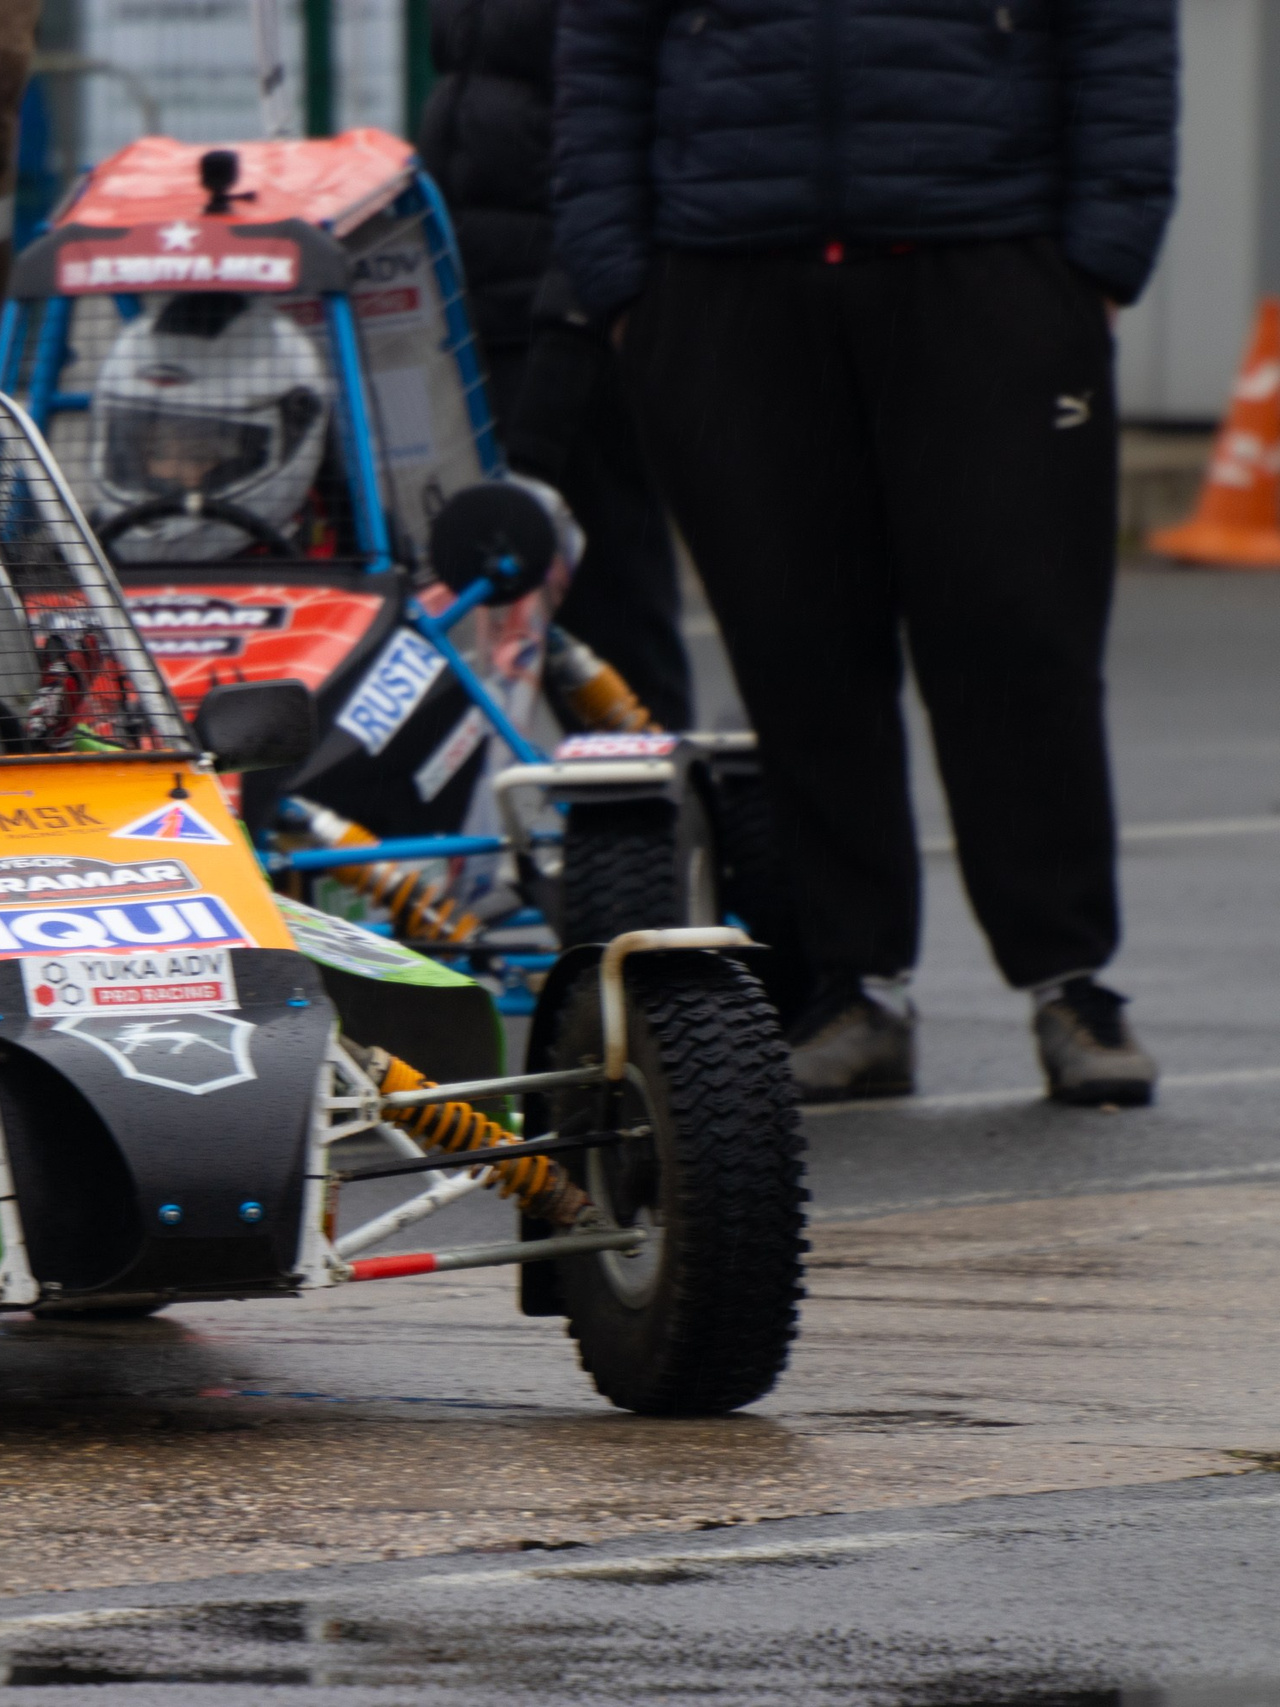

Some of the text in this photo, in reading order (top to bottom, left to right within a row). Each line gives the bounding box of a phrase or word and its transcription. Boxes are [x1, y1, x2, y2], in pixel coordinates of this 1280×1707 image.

[349, 638, 436, 744] RUSTA
[81, 959, 155, 983] YUKA
[164, 953, 225, 979] ADV
[98, 986, 217, 1003] PRO RACING
